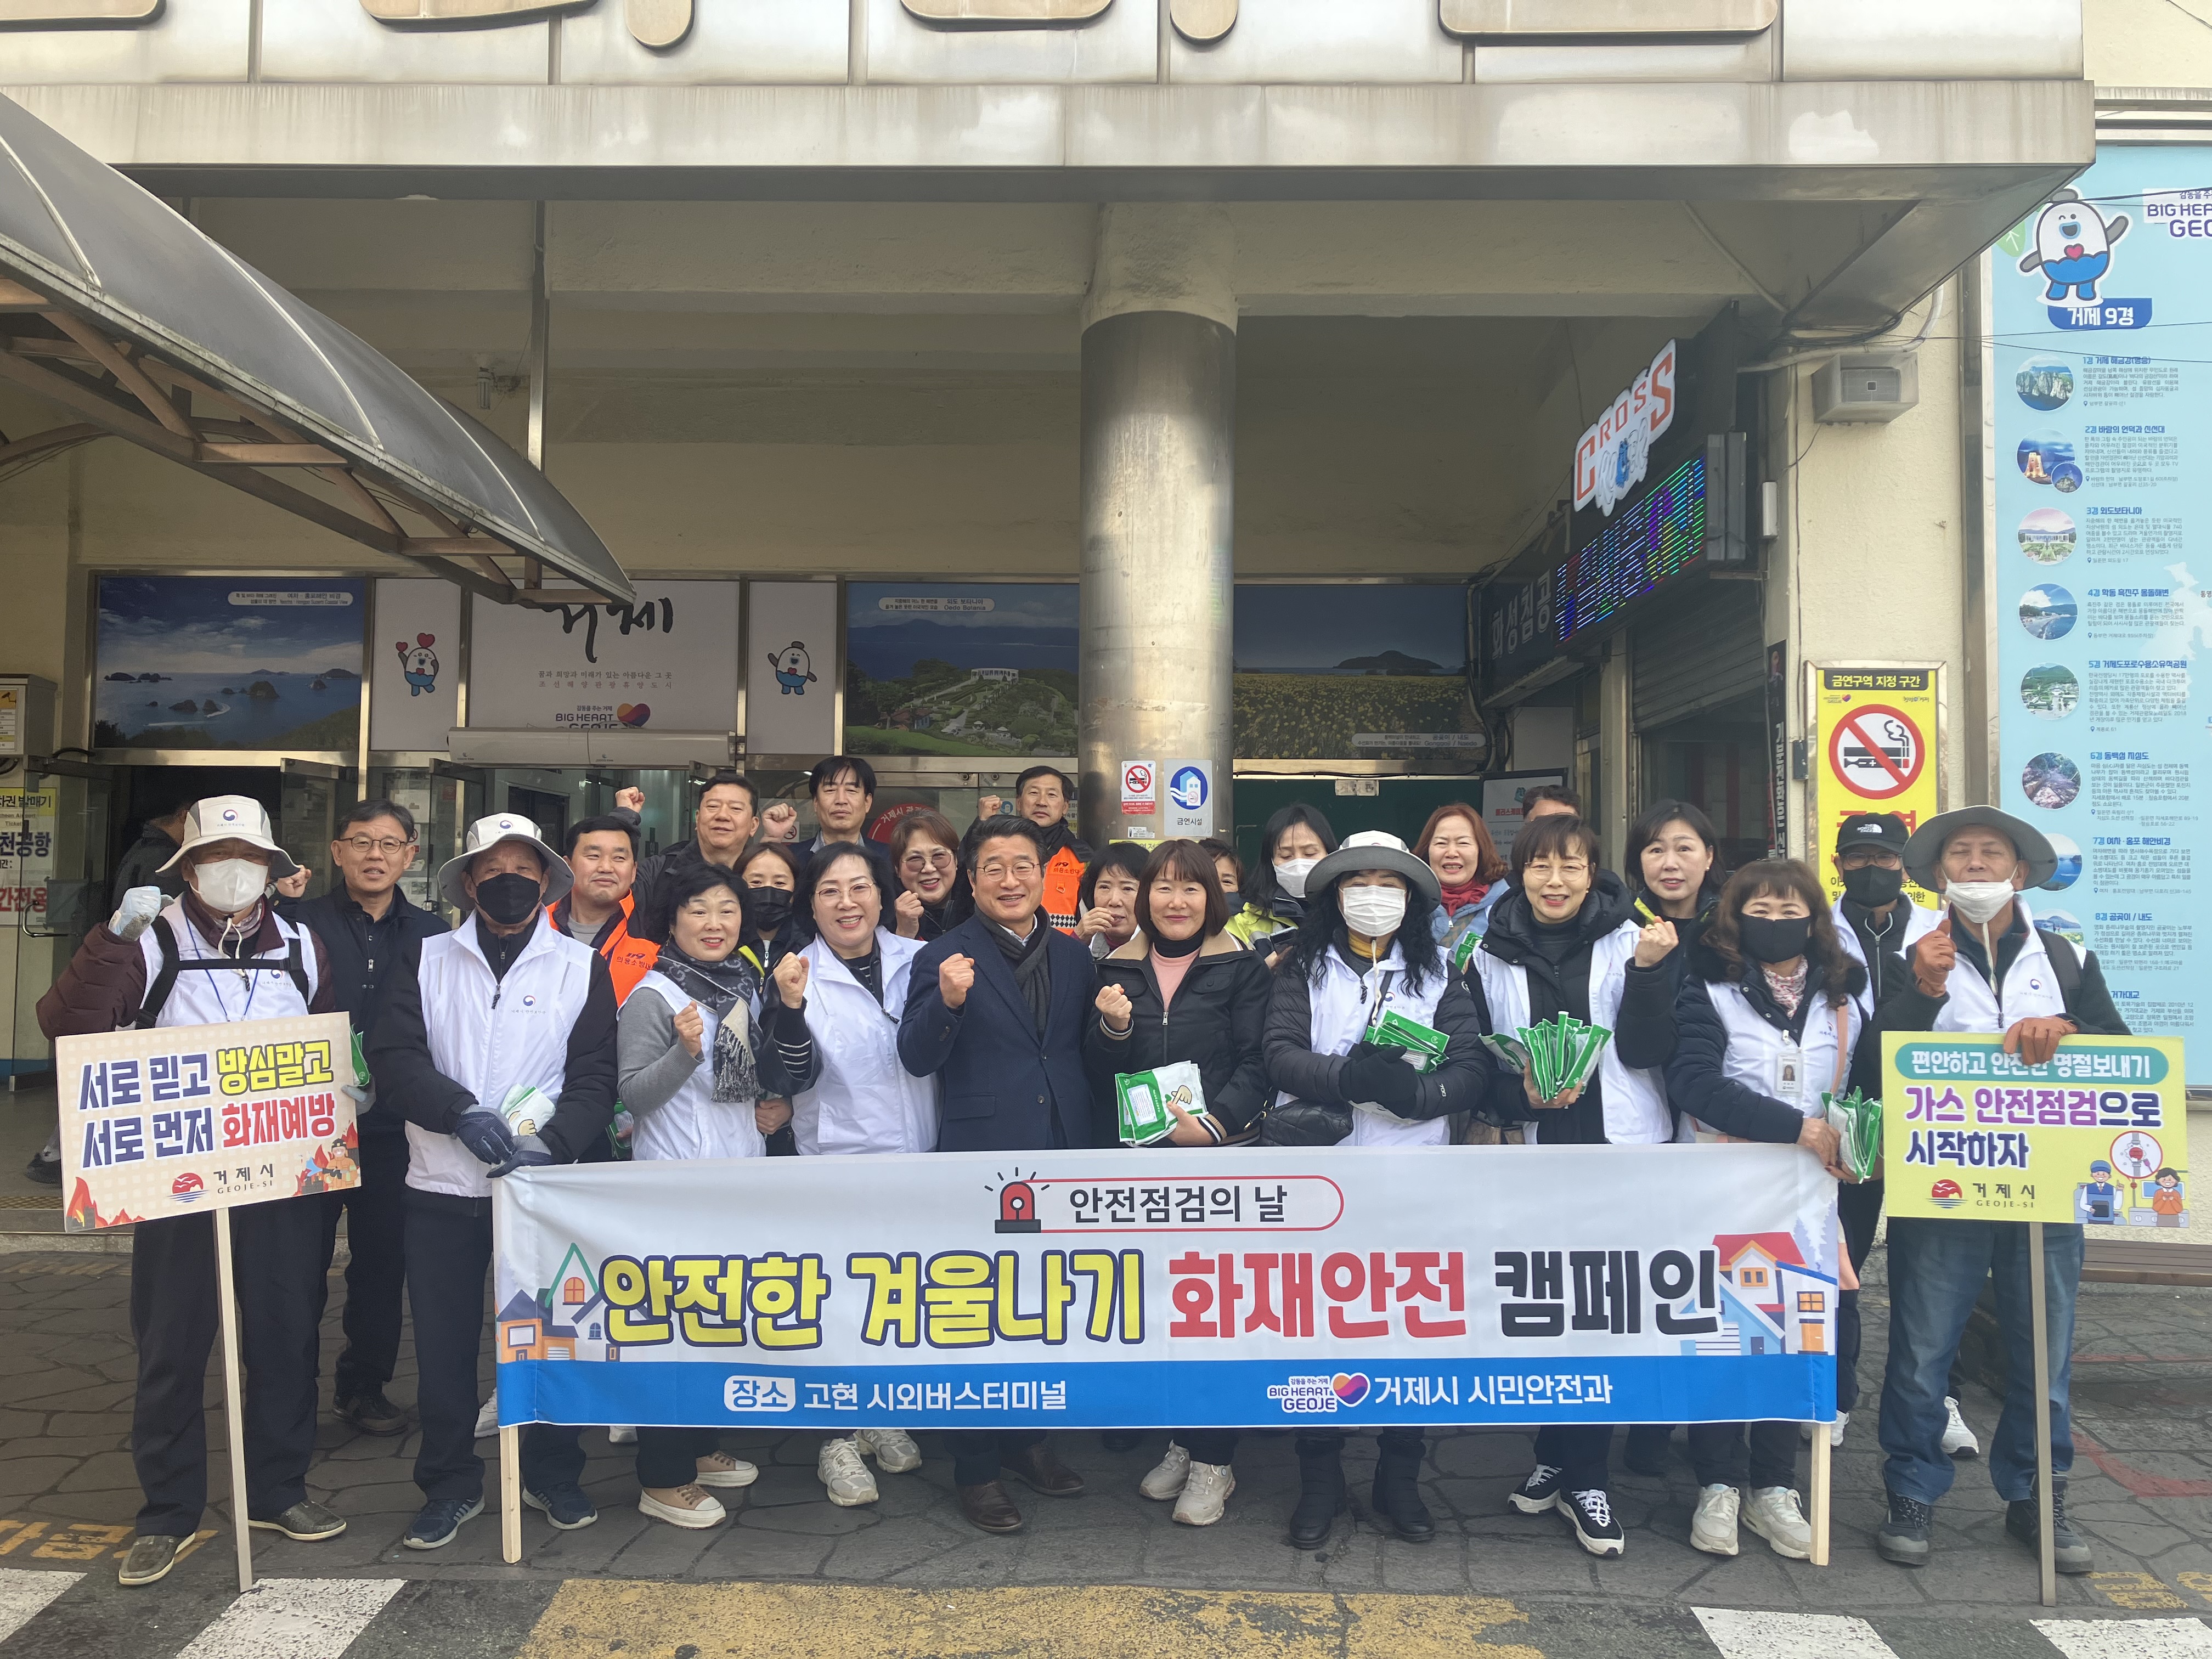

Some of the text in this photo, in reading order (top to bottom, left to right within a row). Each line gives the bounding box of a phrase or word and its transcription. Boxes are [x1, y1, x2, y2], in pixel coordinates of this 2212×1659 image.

[2147, 204, 2176, 216] BIG
[2067, 307, 2134, 326] 거제 9경
[1576, 352, 1673, 501] CROSS
[1832, 675, 1921, 687] 금연구역 지정 구간
[881, 806, 904, 823] 거제시
[1177, 817, 1203, 826] 금연시설
[79, 1040, 334, 1110] 서로 믿고 방심말고
[1911, 1051, 1988, 1075] 편안하고
[2053, 1053, 2151, 1079] 명절보내기
[1905, 1086, 2162, 1127] 가스 안전점검으로
[83, 1093, 335, 1169] 서로 먼저 화재예방
[1906, 1130, 2029, 1168] 시작하자
[217, 1180, 274, 1194] GEOJE-SI
[1069, 1184, 1288, 1224] 안전점검의 날
[1976, 1199, 2035, 1209] GEOJE-SI
[599, 1246, 1721, 1349] 안전한 겨울나기 화재안전 캠페인
[731, 1378, 1067, 1412] 장소 고현 시외버스터미널
[1269, 1387, 1329, 1397] BIG HEART
[1284, 1398, 1335, 1410] GEOJE
[1374, 1374, 1613, 1406] 거제시 시민안전과
